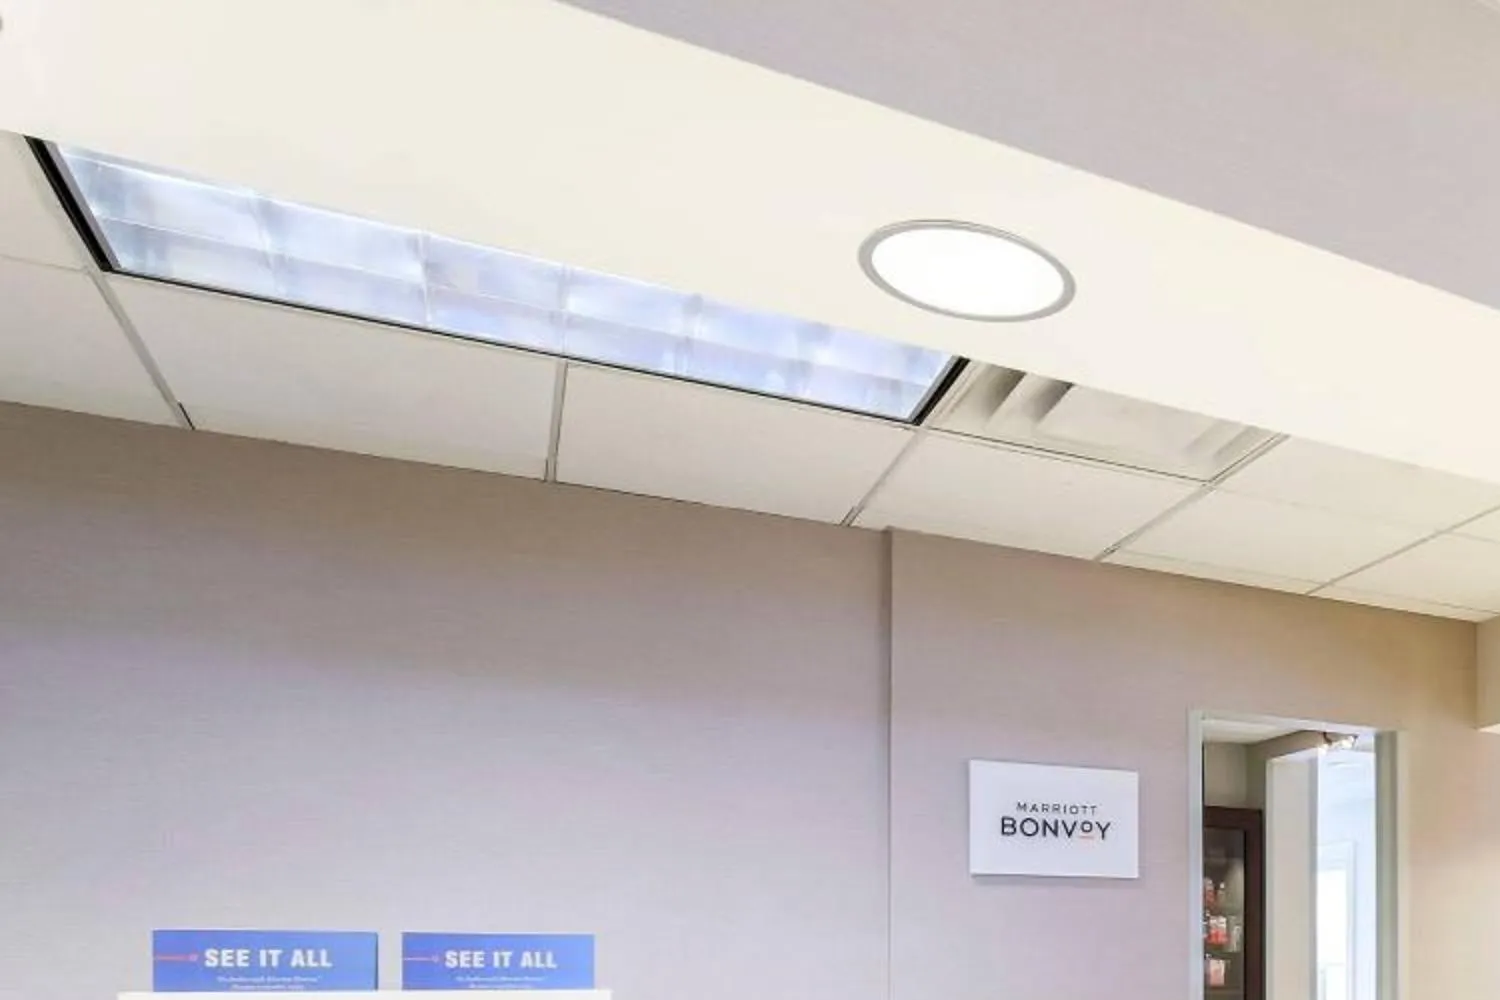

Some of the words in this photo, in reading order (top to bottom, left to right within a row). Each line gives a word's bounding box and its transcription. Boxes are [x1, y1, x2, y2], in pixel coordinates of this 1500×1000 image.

[1015, 801, 1098, 816] MARRIOTT
[1000, 815, 1111, 840] BONVOY
[204, 948, 251, 968] SEE
[259, 948, 283, 968] IT
[290, 948, 333, 968] ALL
[444, 950, 485, 969] SEE
[492, 950, 513, 969] IT
[520, 950, 559, 969] ALL
